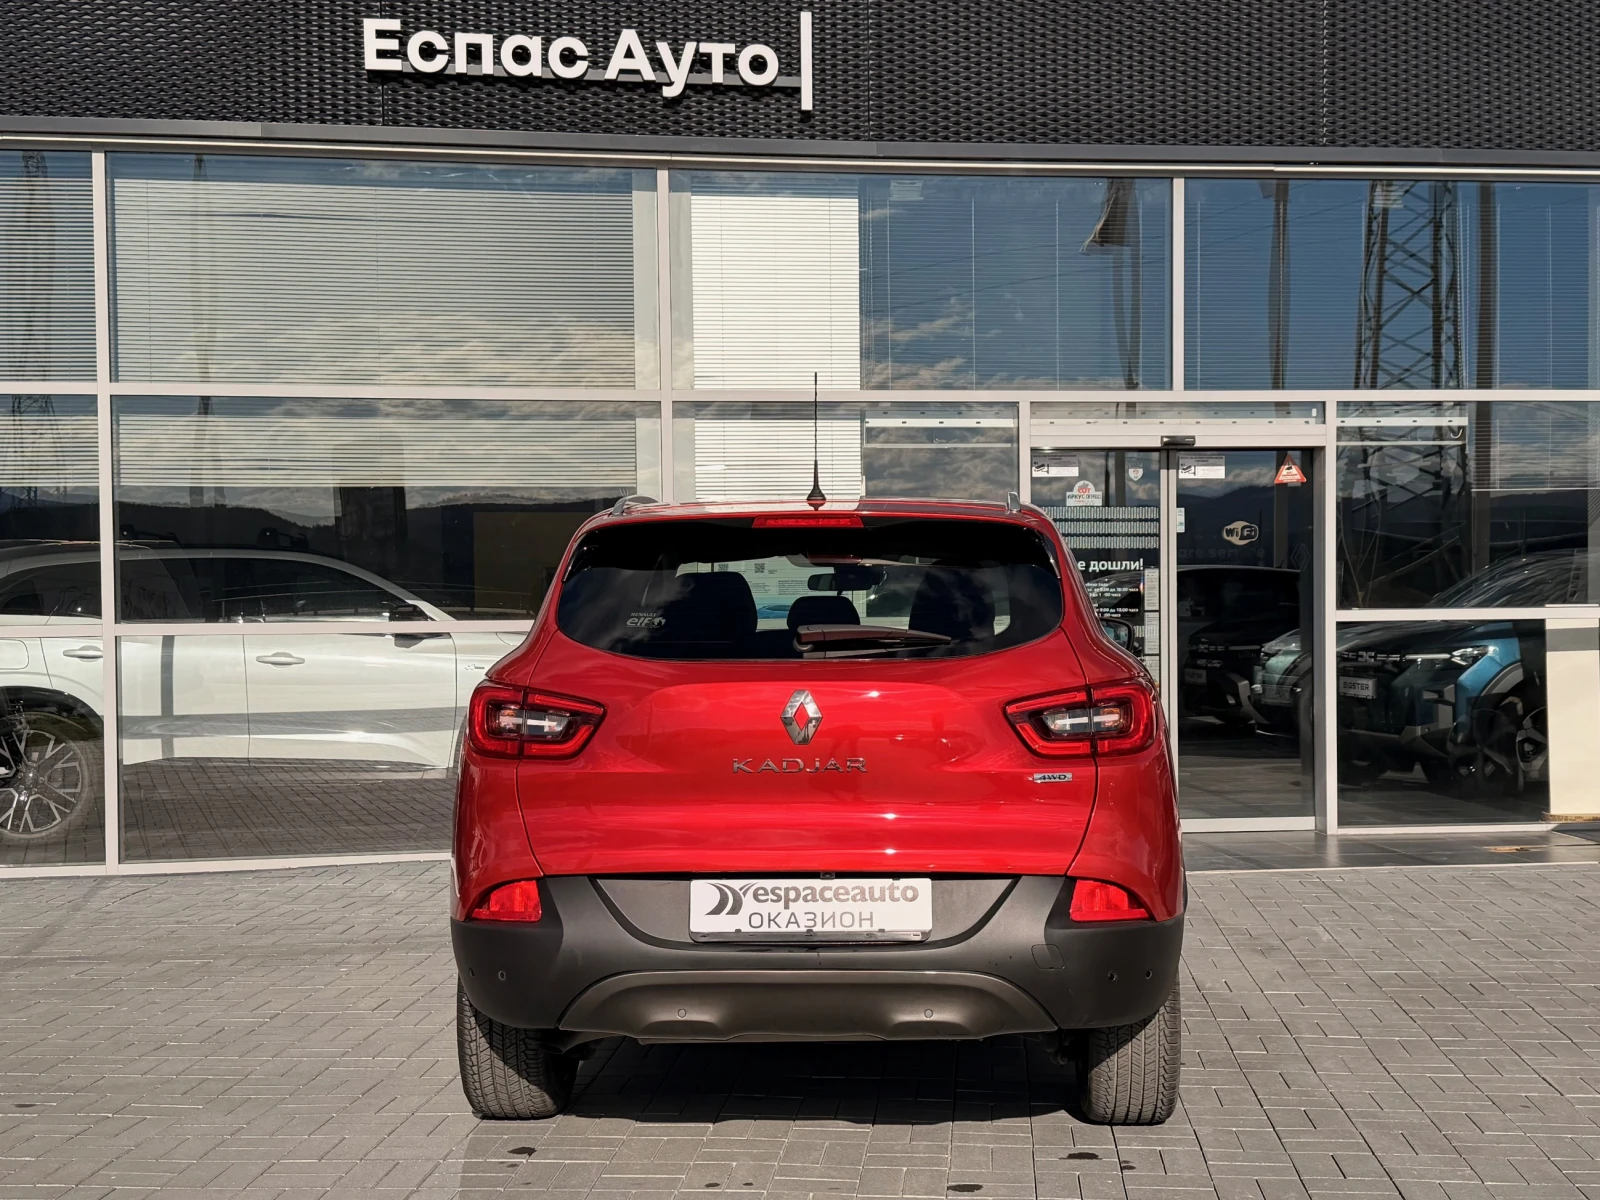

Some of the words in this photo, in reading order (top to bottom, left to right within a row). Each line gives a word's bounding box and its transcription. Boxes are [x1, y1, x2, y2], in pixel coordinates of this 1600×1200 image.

[363, 18, 589, 79] Еспас
[604, 28, 779, 98] Ауто
[1088, 557, 1144, 573] дошли!
[732, 757, 868, 774] KADJAR
[752, 881, 920, 910] espaceauto
[748, 911, 875, 929] ОКАЗИОН
